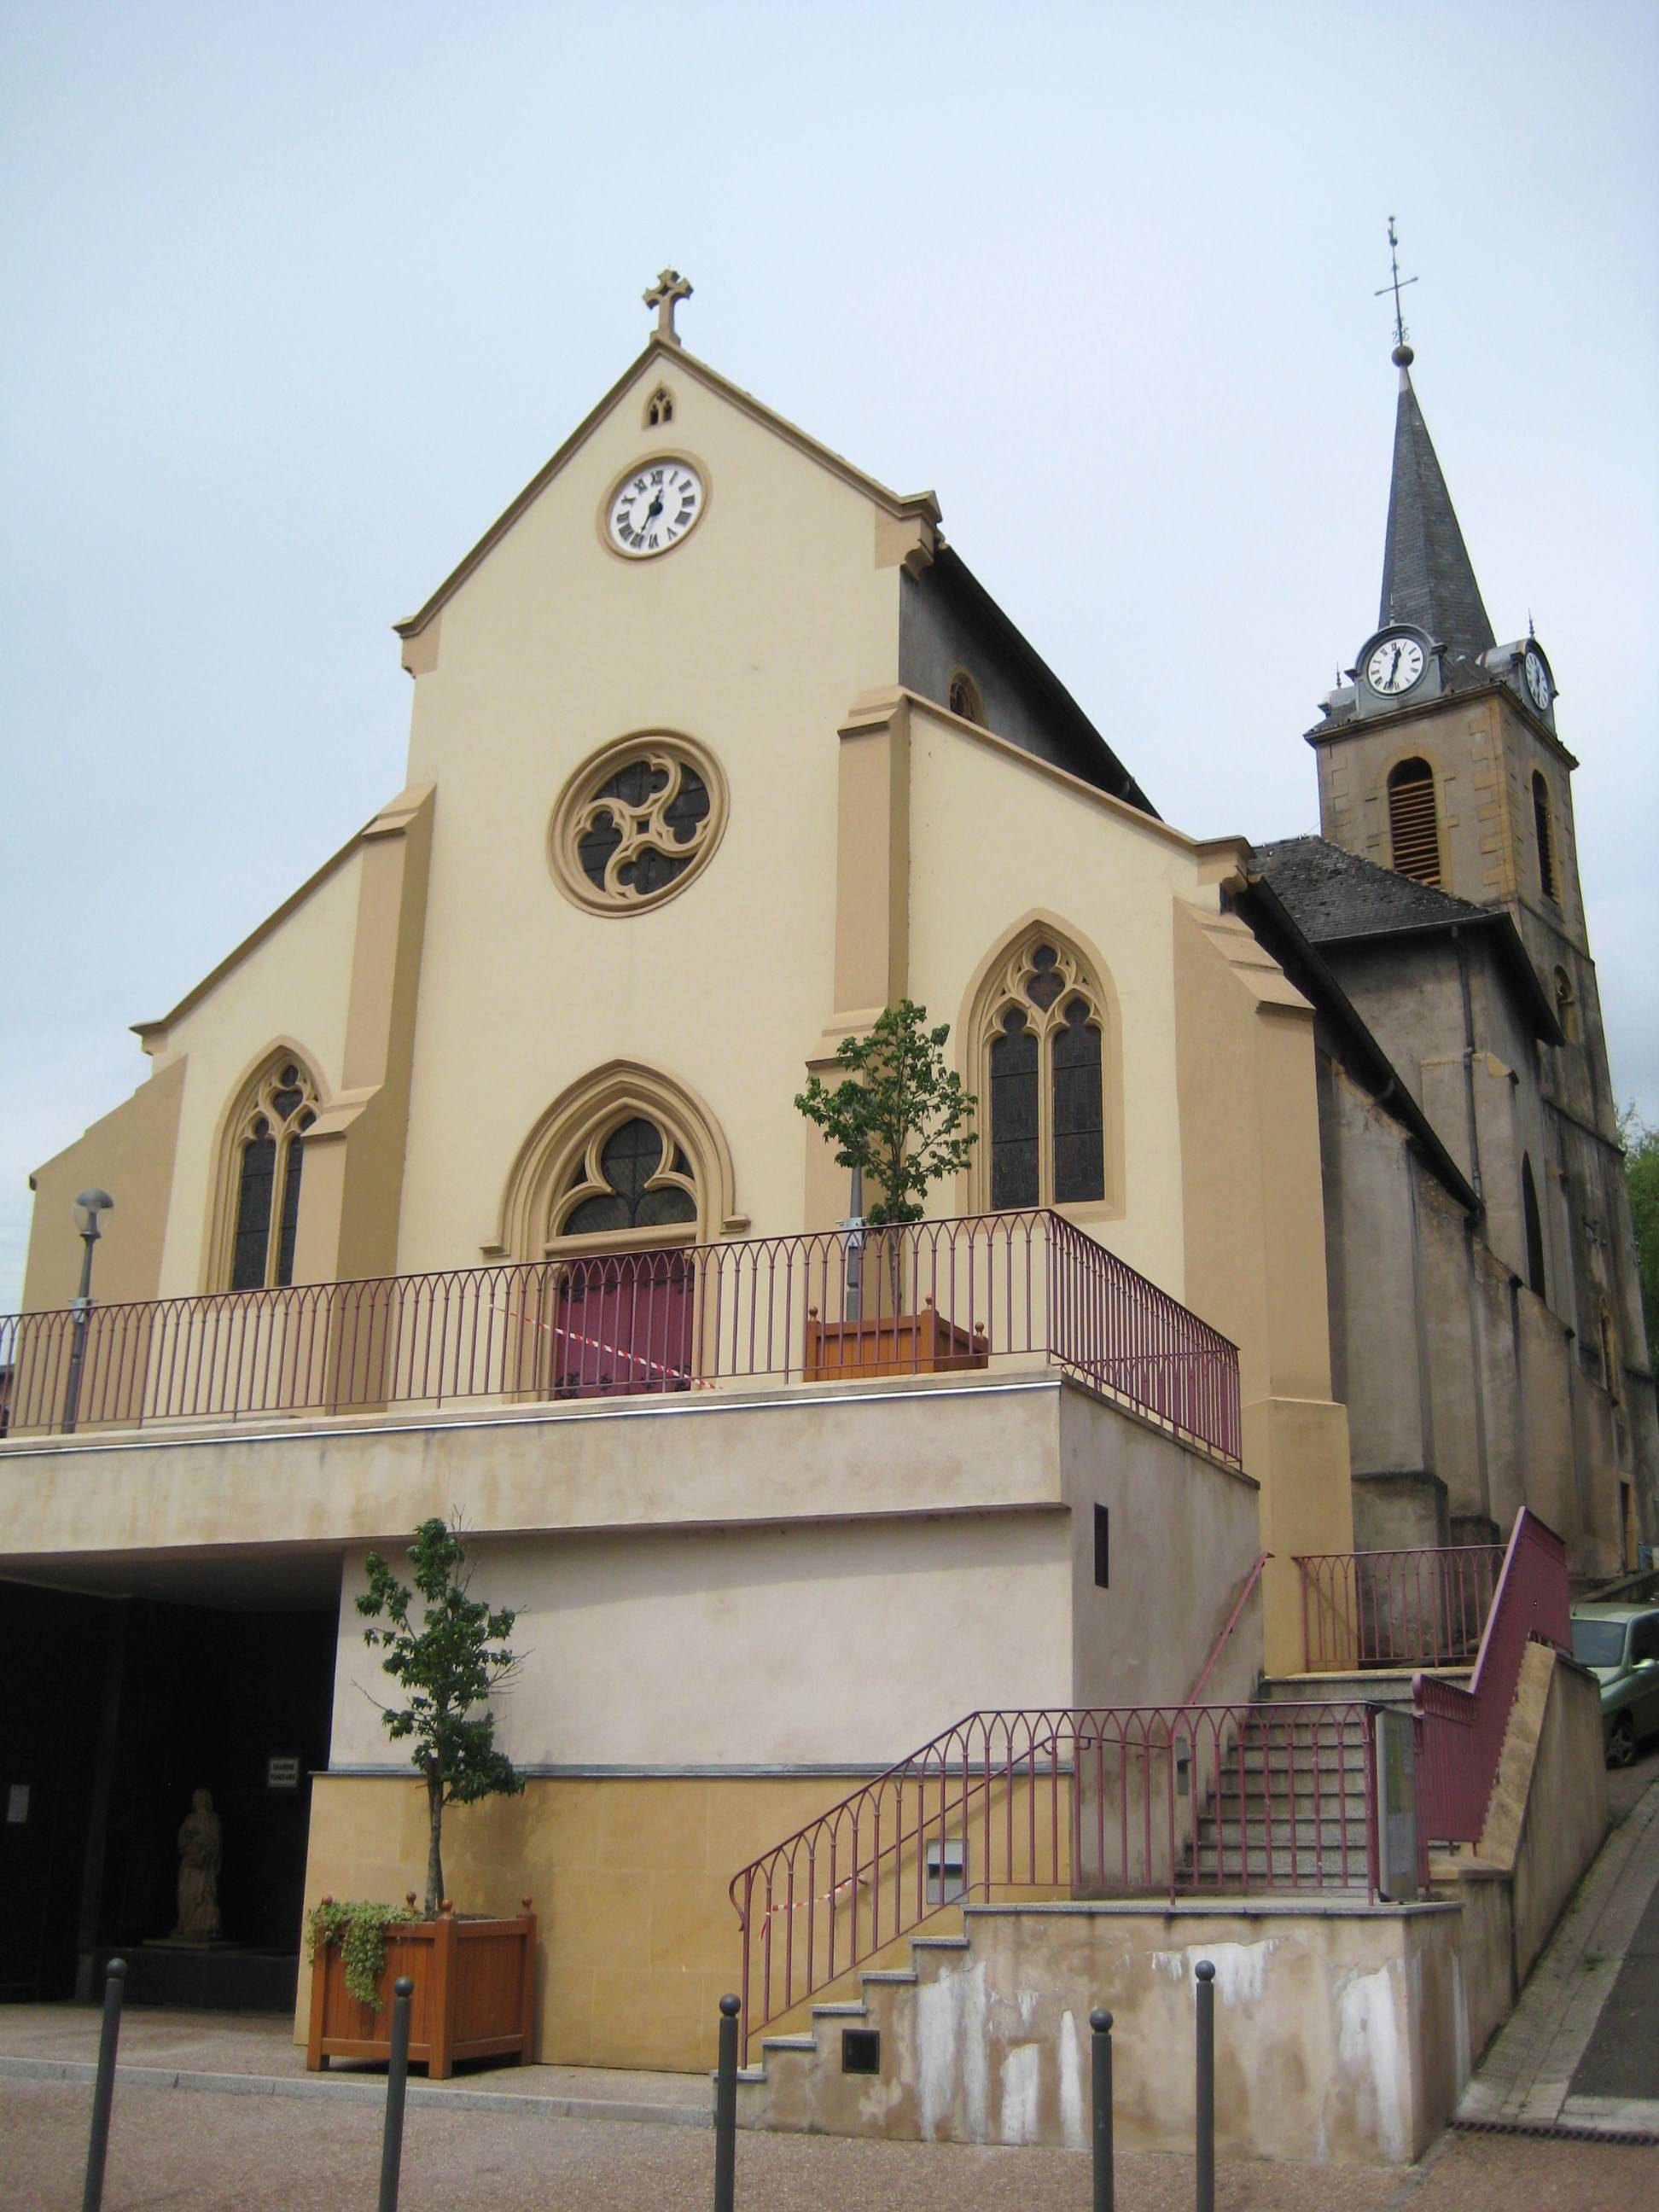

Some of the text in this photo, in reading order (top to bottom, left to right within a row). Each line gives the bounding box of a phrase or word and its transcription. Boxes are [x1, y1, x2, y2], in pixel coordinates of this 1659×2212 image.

[650, 469, 664, 486] XII
[669, 470, 678, 486] I
[621, 495, 637, 505] X
[667, 527, 678, 541] V
